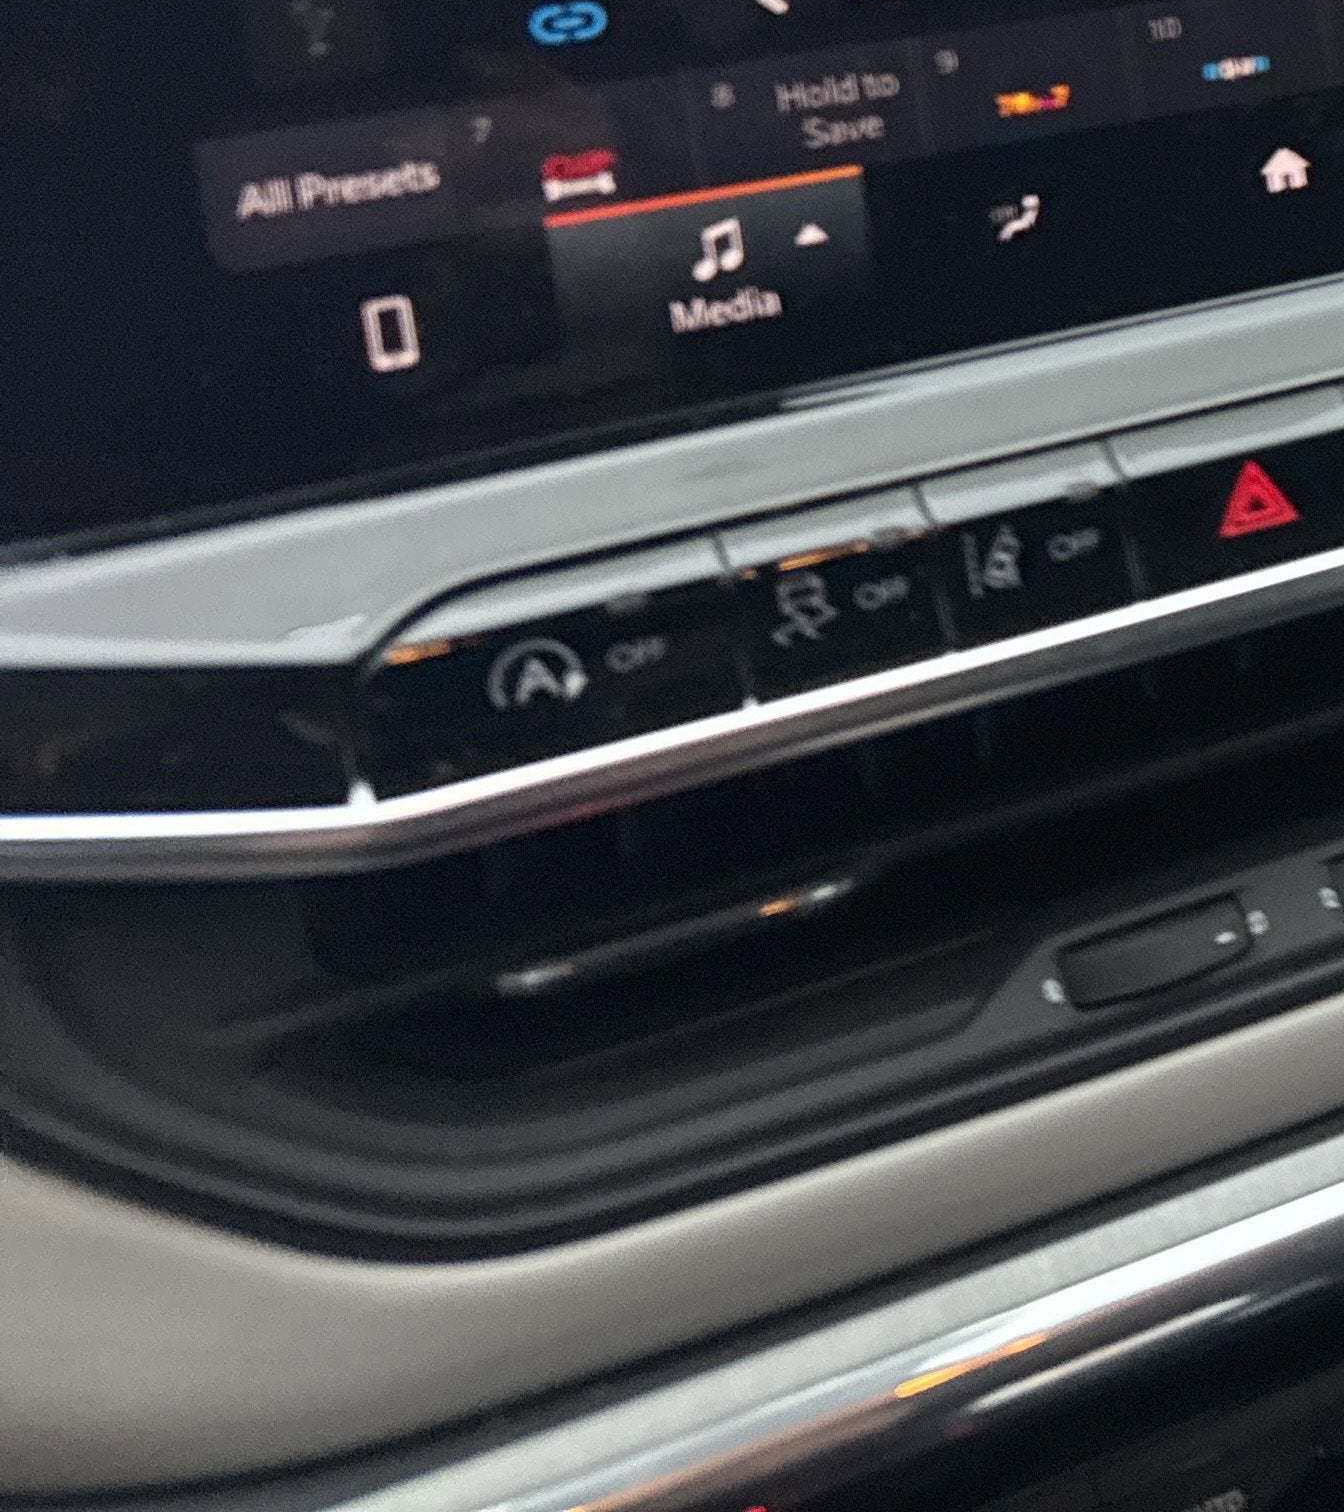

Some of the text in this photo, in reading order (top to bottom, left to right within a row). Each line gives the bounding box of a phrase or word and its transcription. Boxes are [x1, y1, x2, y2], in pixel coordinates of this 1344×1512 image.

[775, 71, 900, 114] Hold to
[801, 112, 886, 151] Save
[235, 160, 441, 220] All Presets
[668, 289, 783, 335] Media
